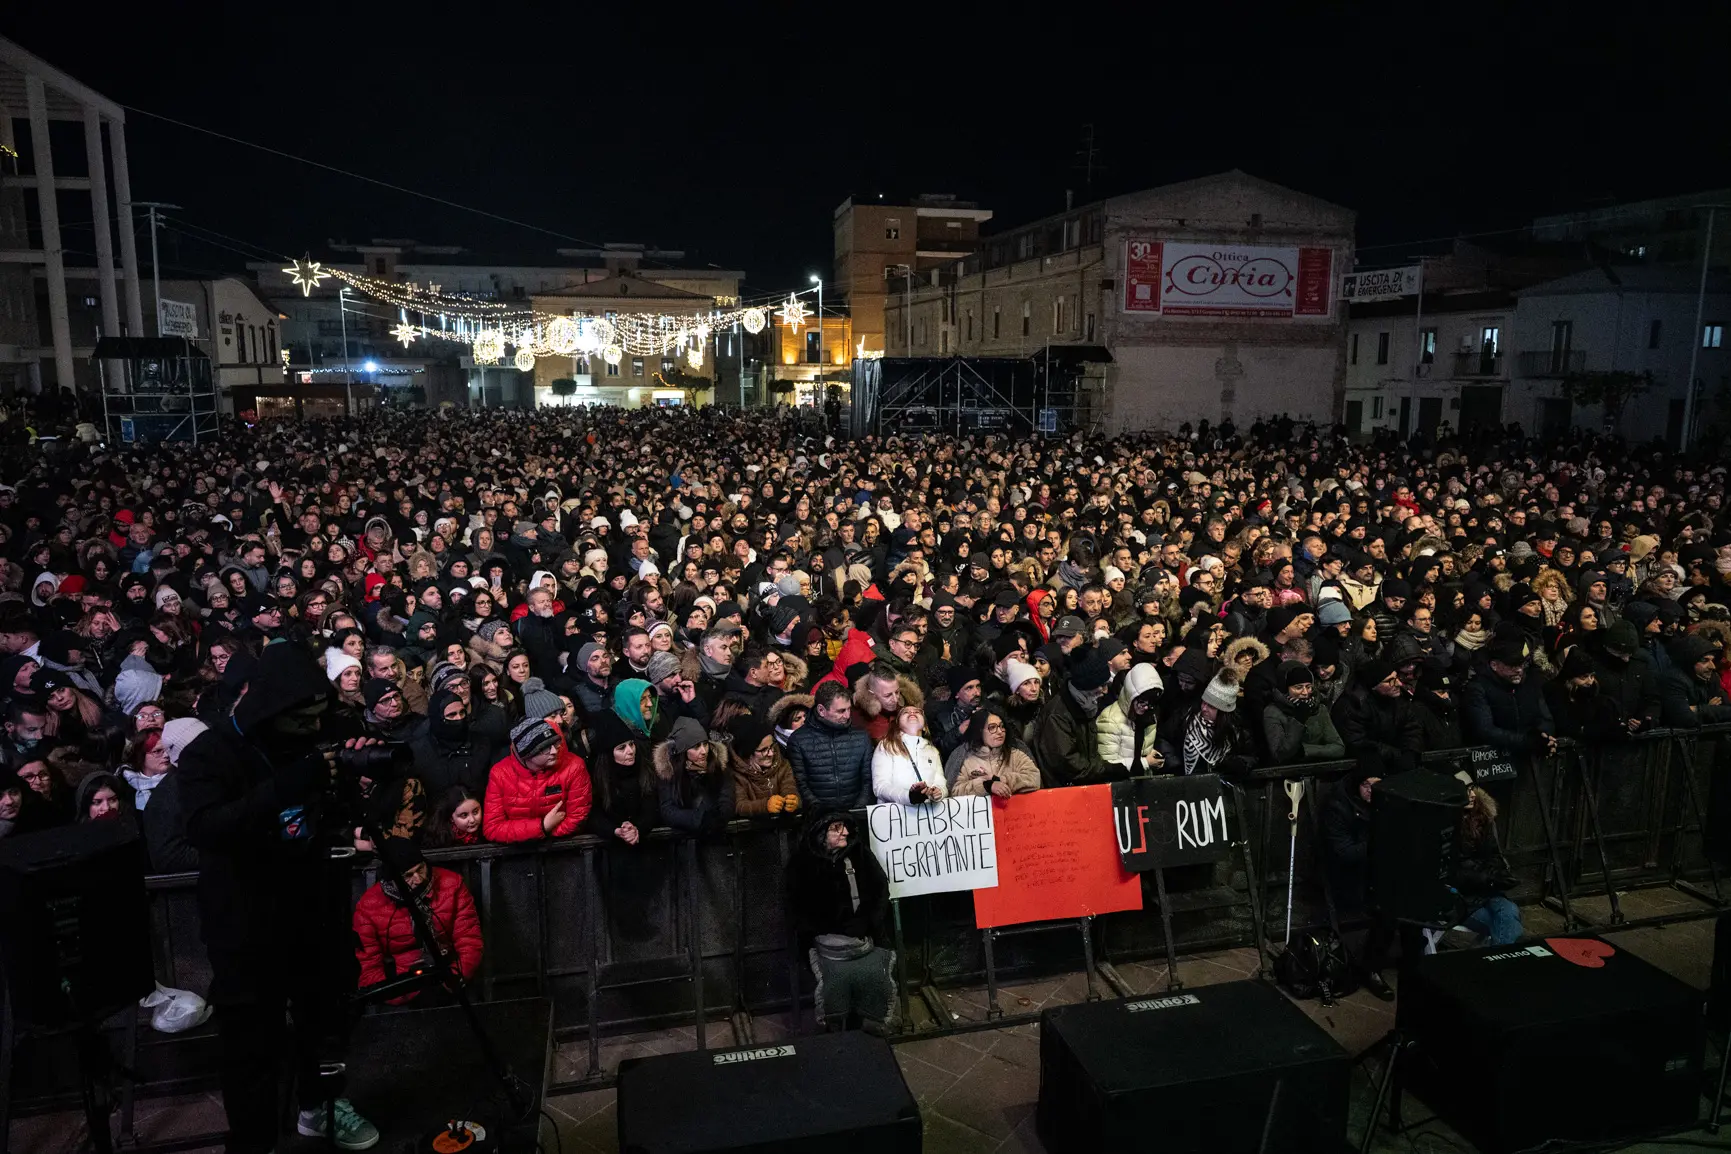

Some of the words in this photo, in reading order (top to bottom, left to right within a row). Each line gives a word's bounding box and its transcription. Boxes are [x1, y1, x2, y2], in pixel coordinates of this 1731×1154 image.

[1212, 251, 1249, 261] Ottica
[1187, 265, 1276, 286] Curia
[1360, 273, 1390, 286] USCITA
[1393, 271, 1404, 283] DI
[1358, 283, 1403, 296] EMERGENZA
[1476, 767, 1490, 778] NON
[1492, 763, 1513, 775] PASSA
[870, 796, 990, 842] CALABRIA
[1176, 796, 1228, 850] RUM
[713, 1047, 778, 1063] outline
